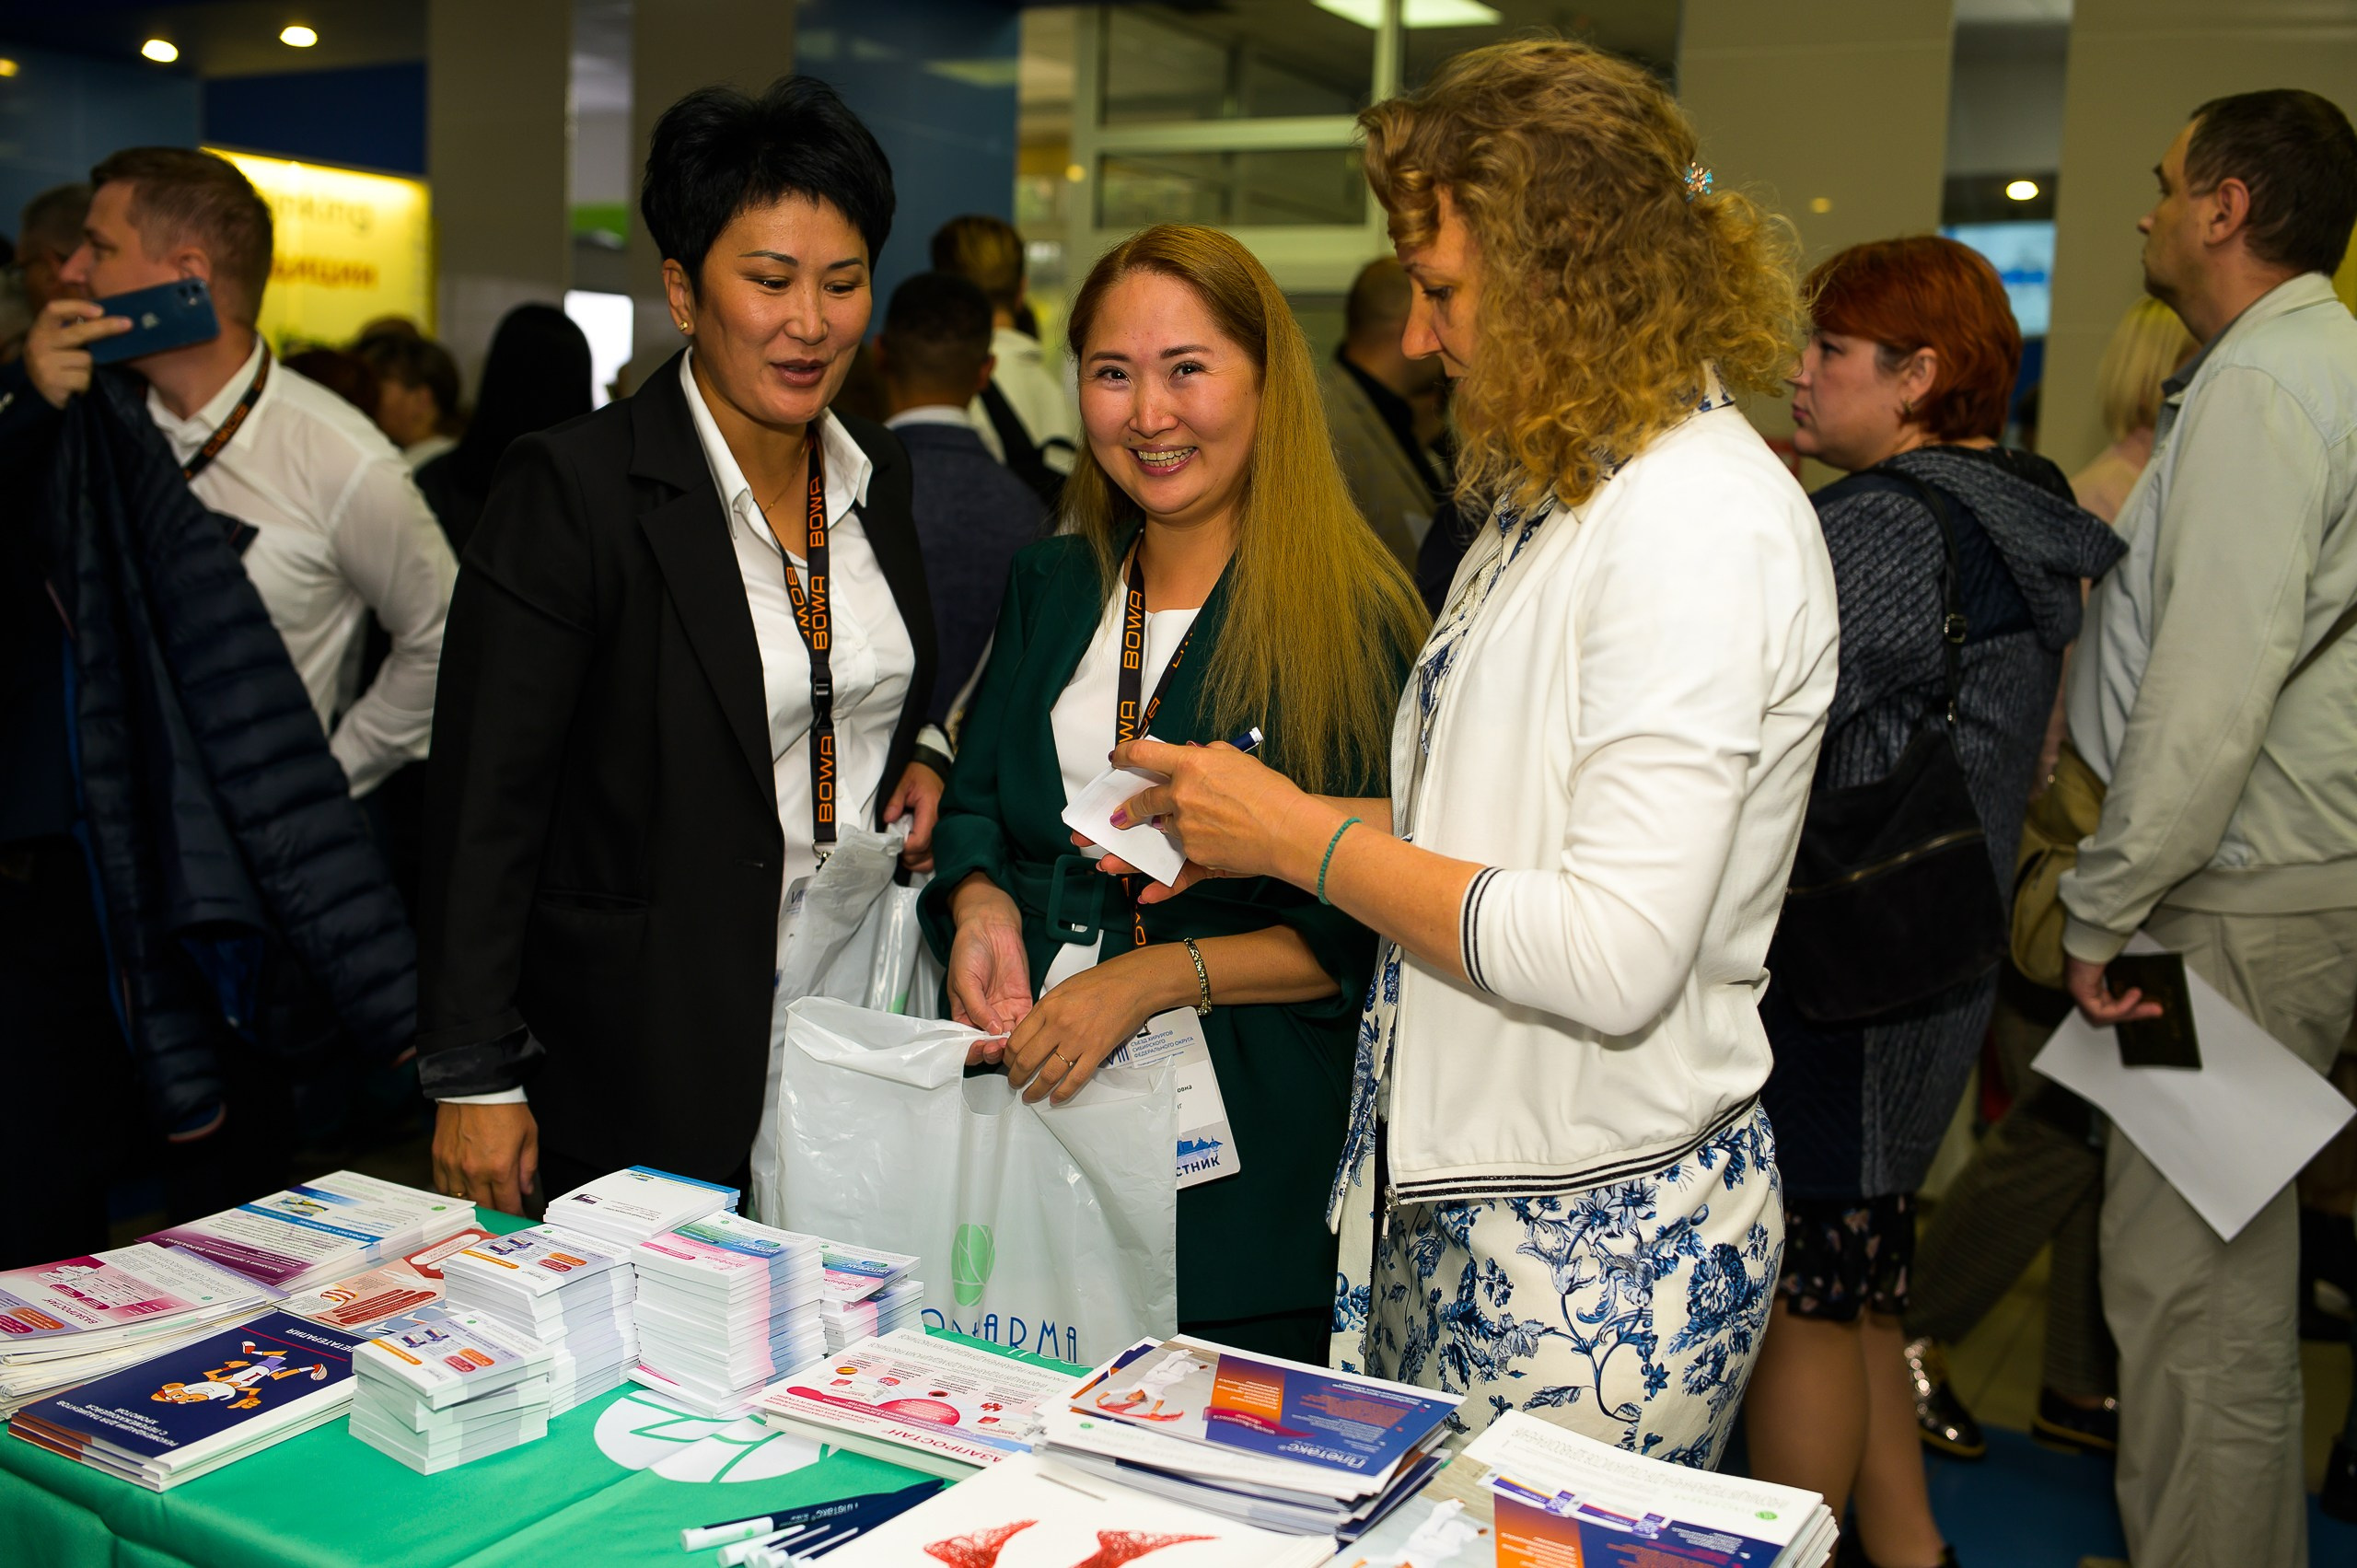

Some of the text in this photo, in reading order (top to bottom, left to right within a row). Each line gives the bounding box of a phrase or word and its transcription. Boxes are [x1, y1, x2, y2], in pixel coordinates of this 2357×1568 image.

[809, 476, 825, 547] BOWA
[786, 566, 810, 639] BOW
[811, 576, 828, 649] BOWA
[1123, 590, 1143, 669] BOWA
[819, 736, 833, 822] BOWA
[1131, 1029, 1174, 1047] СЪЕЗД ХИРУРГОВ
[1132, 1038, 1167, 1052] СИБИРСКОГО
[1133, 1036, 1194, 1058] ФЕДЕРАЛЬНОГО ОКРУГА
[55, 1400, 102, 1422] ПАЦИЕНТОВ
[114, 1408, 158, 1424] ХРОМОТОЙ
[1277, 1442, 1366, 1469] Плетакс®
